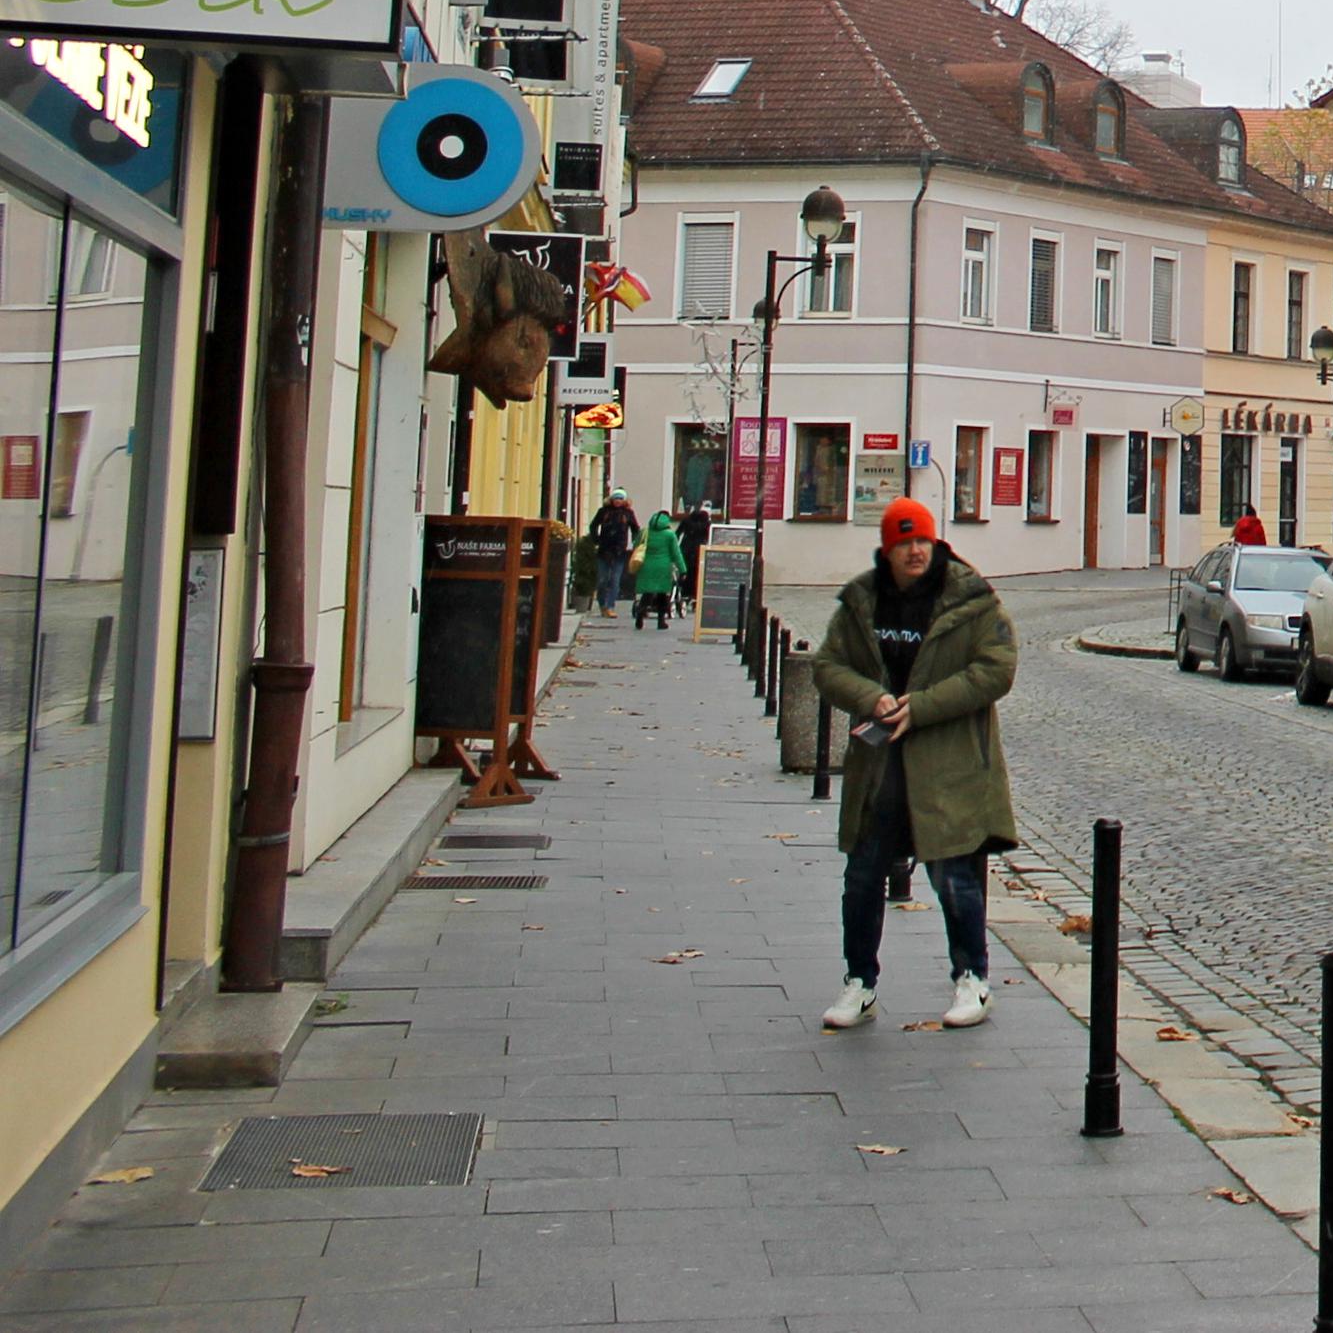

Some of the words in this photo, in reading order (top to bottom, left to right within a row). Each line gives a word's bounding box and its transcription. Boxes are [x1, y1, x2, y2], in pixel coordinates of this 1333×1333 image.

[595, 74, 606, 83] &
[594, 90, 606, 135] suites
[1222, 400, 1313, 434] LÉKÁRNA
